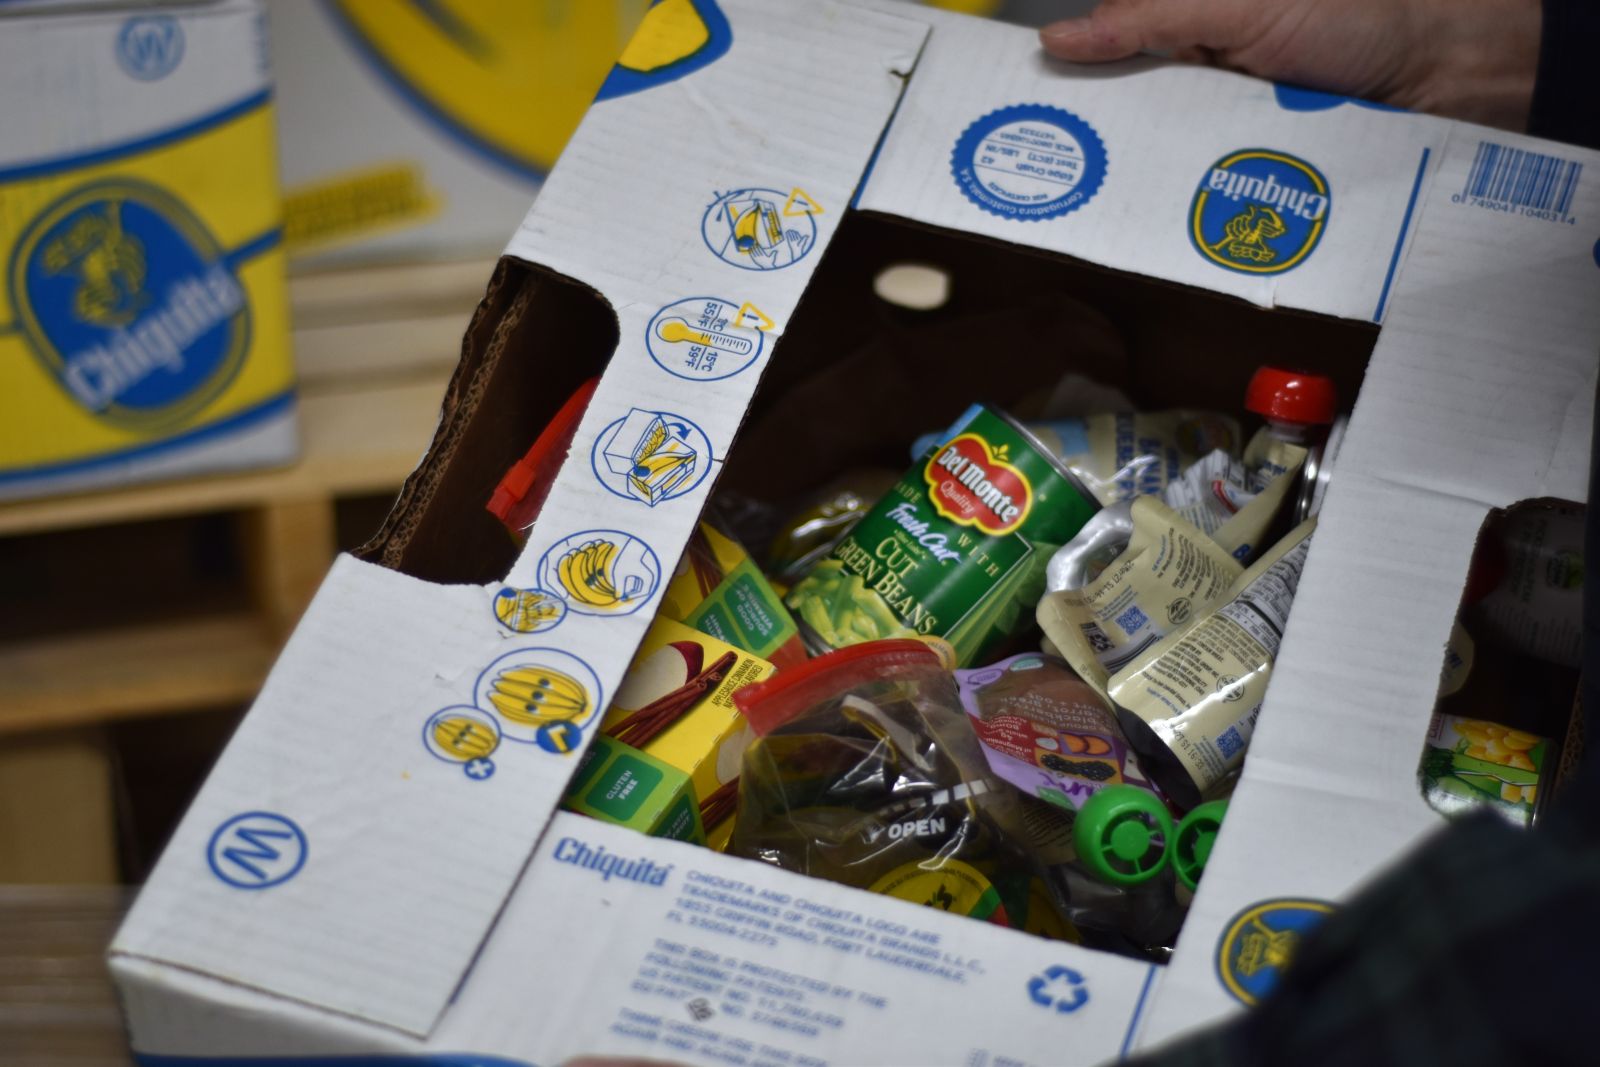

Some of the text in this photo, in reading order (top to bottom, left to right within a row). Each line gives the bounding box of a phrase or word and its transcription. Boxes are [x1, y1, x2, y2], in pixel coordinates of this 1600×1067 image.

[1016, 163, 1046, 176] Crush
[1048, 169, 1074, 182] Edge
[1055, 159, 1078, 171] Test
[1208, 168, 1328, 220] Chiquita
[1451, 194, 1461, 203] 0
[65, 264, 245, 412] Chiquita
[685, 346, 703, 369] 59°F
[701, 351, 719, 372] 15°C
[937, 446, 1020, 523] Del Monte
[940, 480, 977, 515] Quality
[886, 503, 924, 540] Fresh
[875, 536, 919, 578] CUT
[956, 533, 1000, 578] WITH
[837, 537, 939, 634] GREEN BEANS
[735, 603, 755, 632] GOOD
[742, 601, 771, 635] SOURCE
[711, 657, 755, 708] APPLESAUCE CINNAMON
[606, 769, 633, 800] GLUTEN
[617, 778, 639, 801] FREE
[887, 818, 946, 840] OPEN
[553, 836, 672, 887] Chiquita
[686, 869, 756, 896] CHIQUITA
[757, 888, 792, 905] AND
[793, 897, 864, 924] CHIQUITA
[866, 917, 908, 936] LOGO
